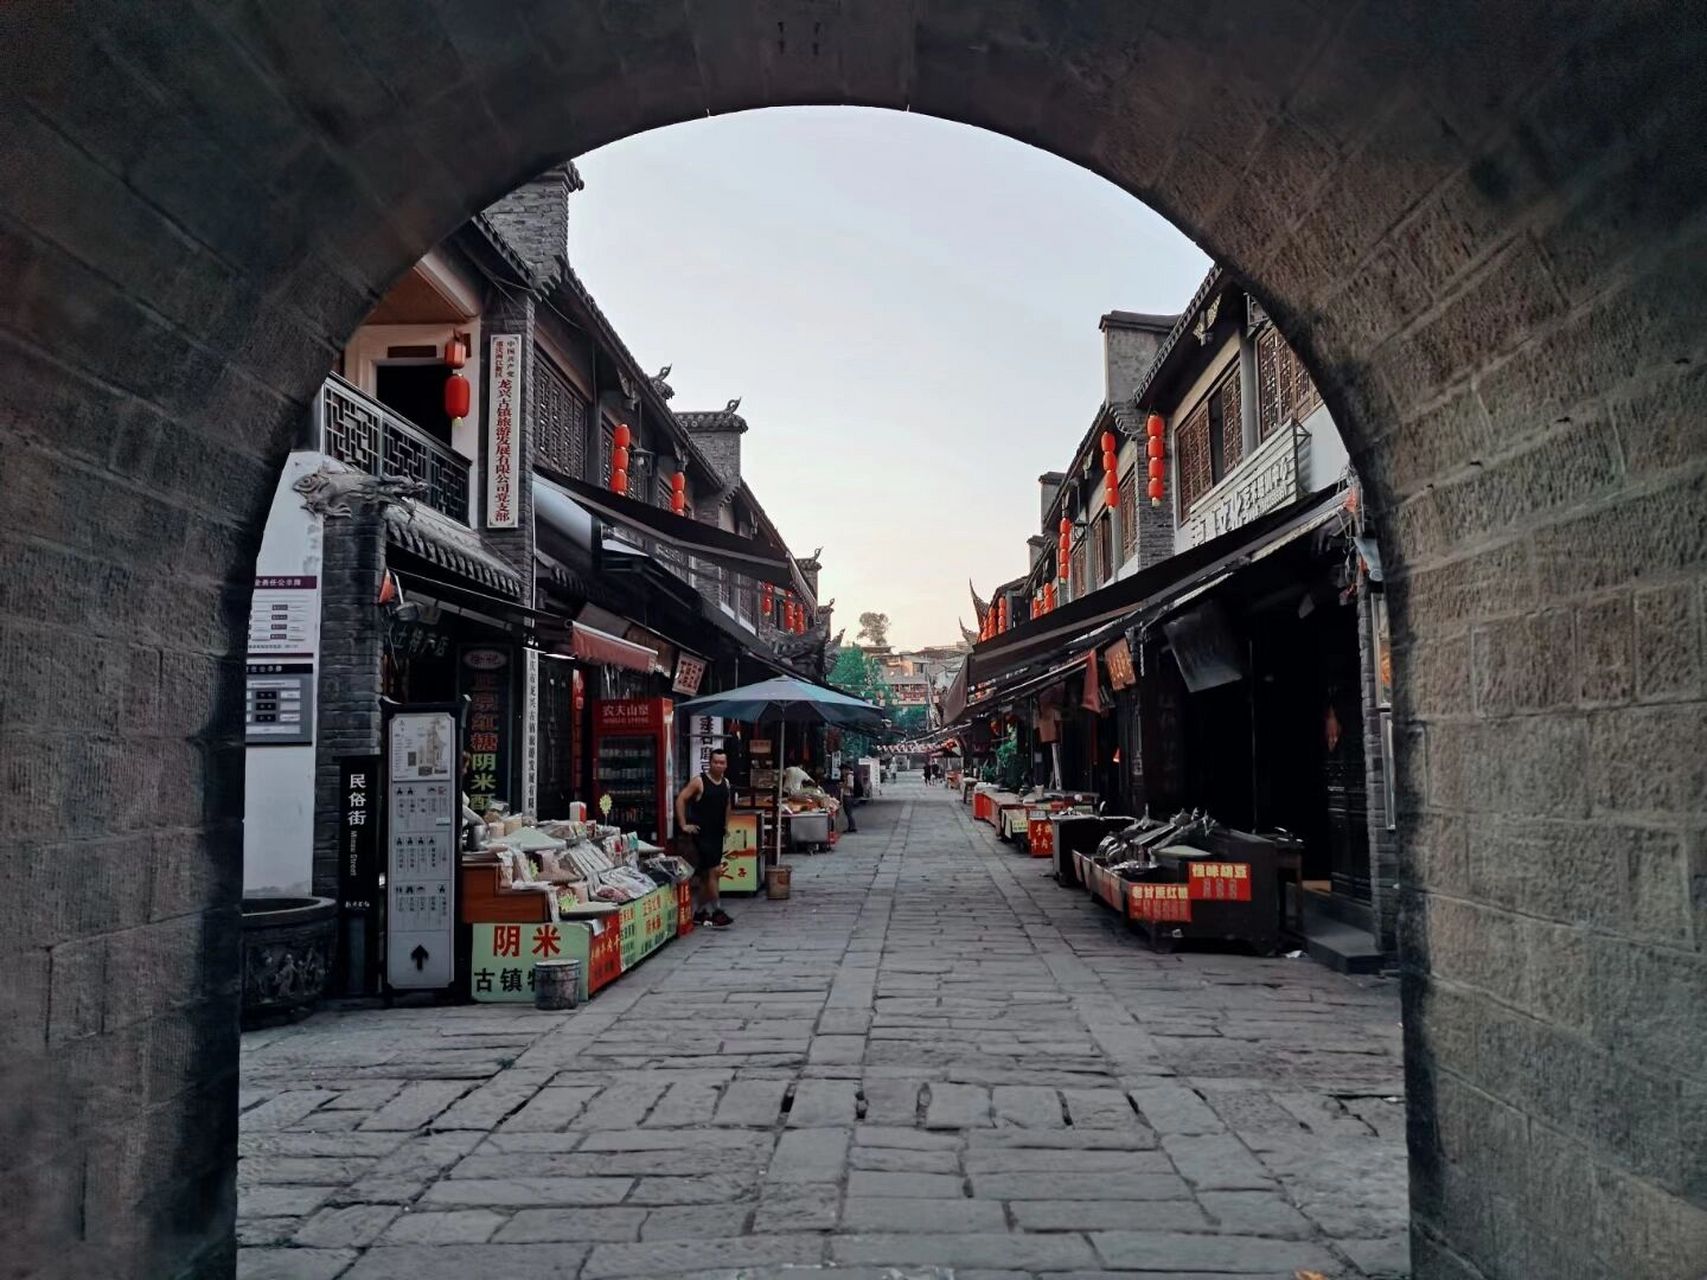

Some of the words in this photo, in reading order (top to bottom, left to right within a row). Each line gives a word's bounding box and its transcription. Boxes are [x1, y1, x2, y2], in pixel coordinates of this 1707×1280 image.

[348, 773, 367, 826] 民俗街
[350, 853, 358, 877] Street
[493, 925, 561, 957] 阴米
